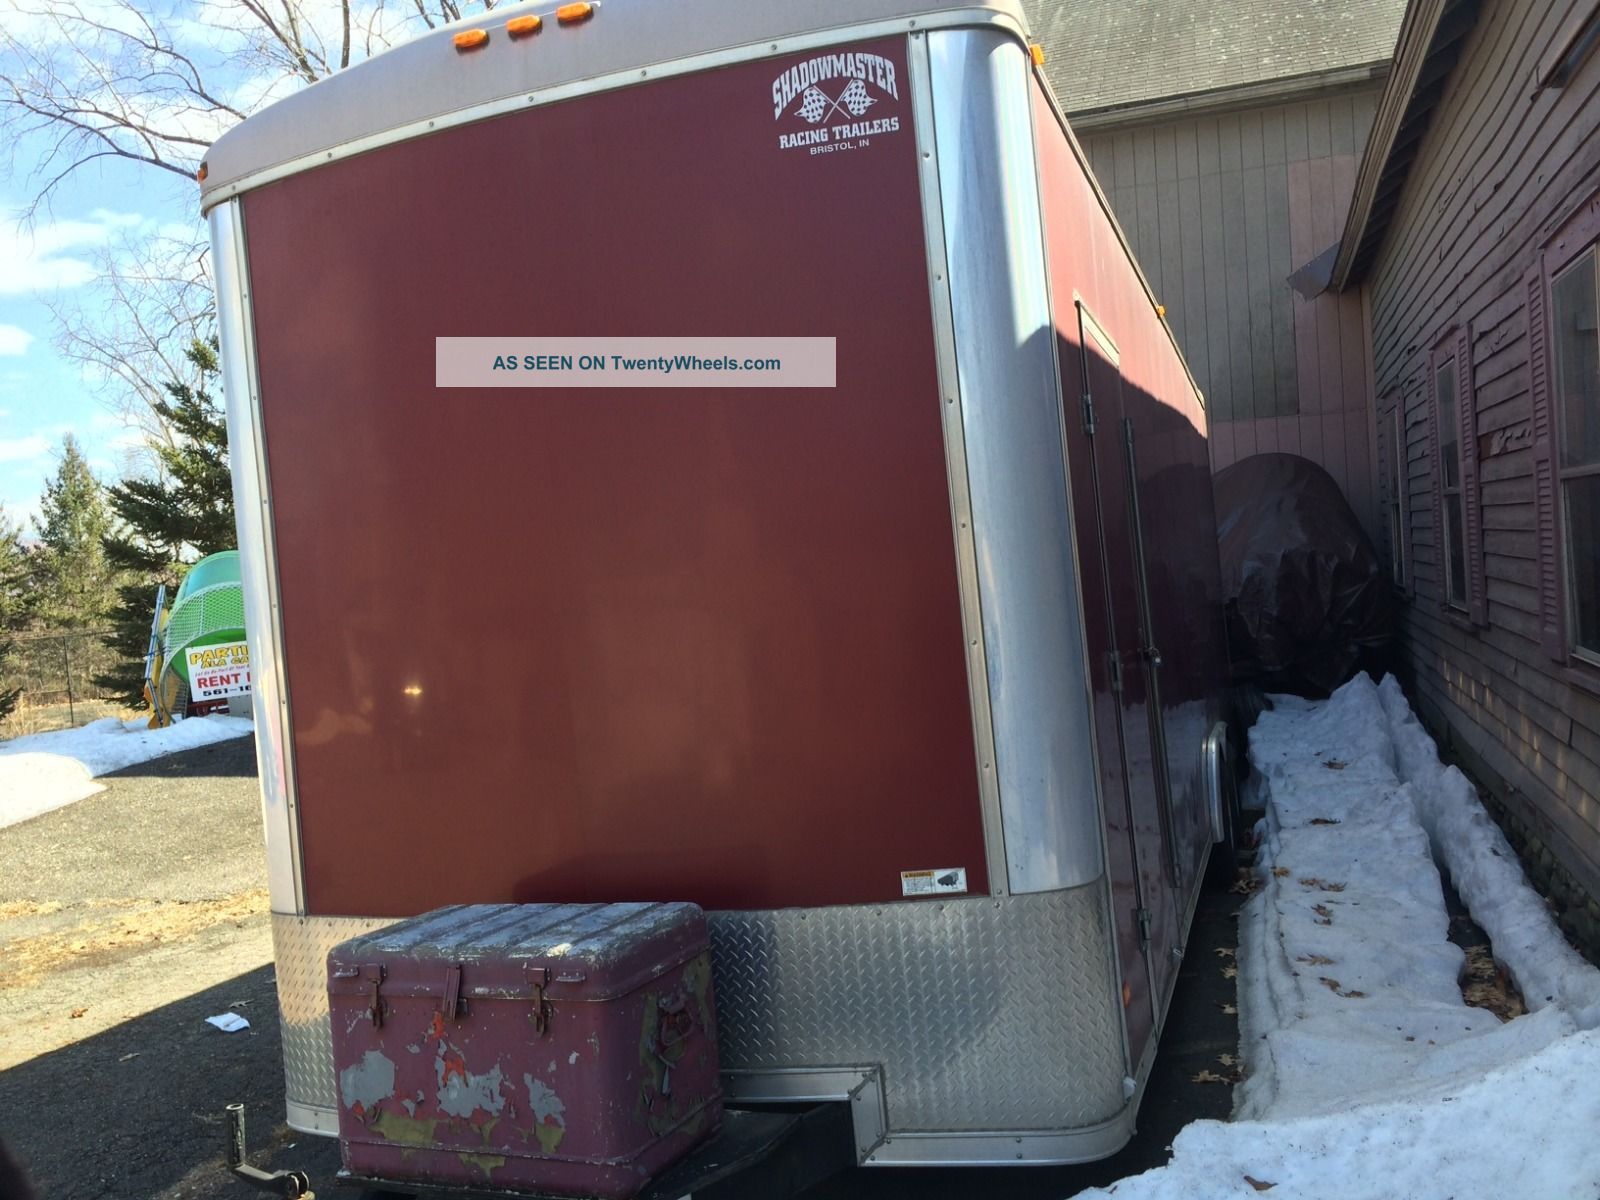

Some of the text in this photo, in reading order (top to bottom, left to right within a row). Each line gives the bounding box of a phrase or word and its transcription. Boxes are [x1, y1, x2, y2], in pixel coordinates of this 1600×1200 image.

[772, 52, 899, 121] SHADOWMASTER
[779, 117, 900, 149] RACING TRAILERS
[810, 138, 870, 155] BRISTOL, IN
[197, 673, 241, 689] RENT
